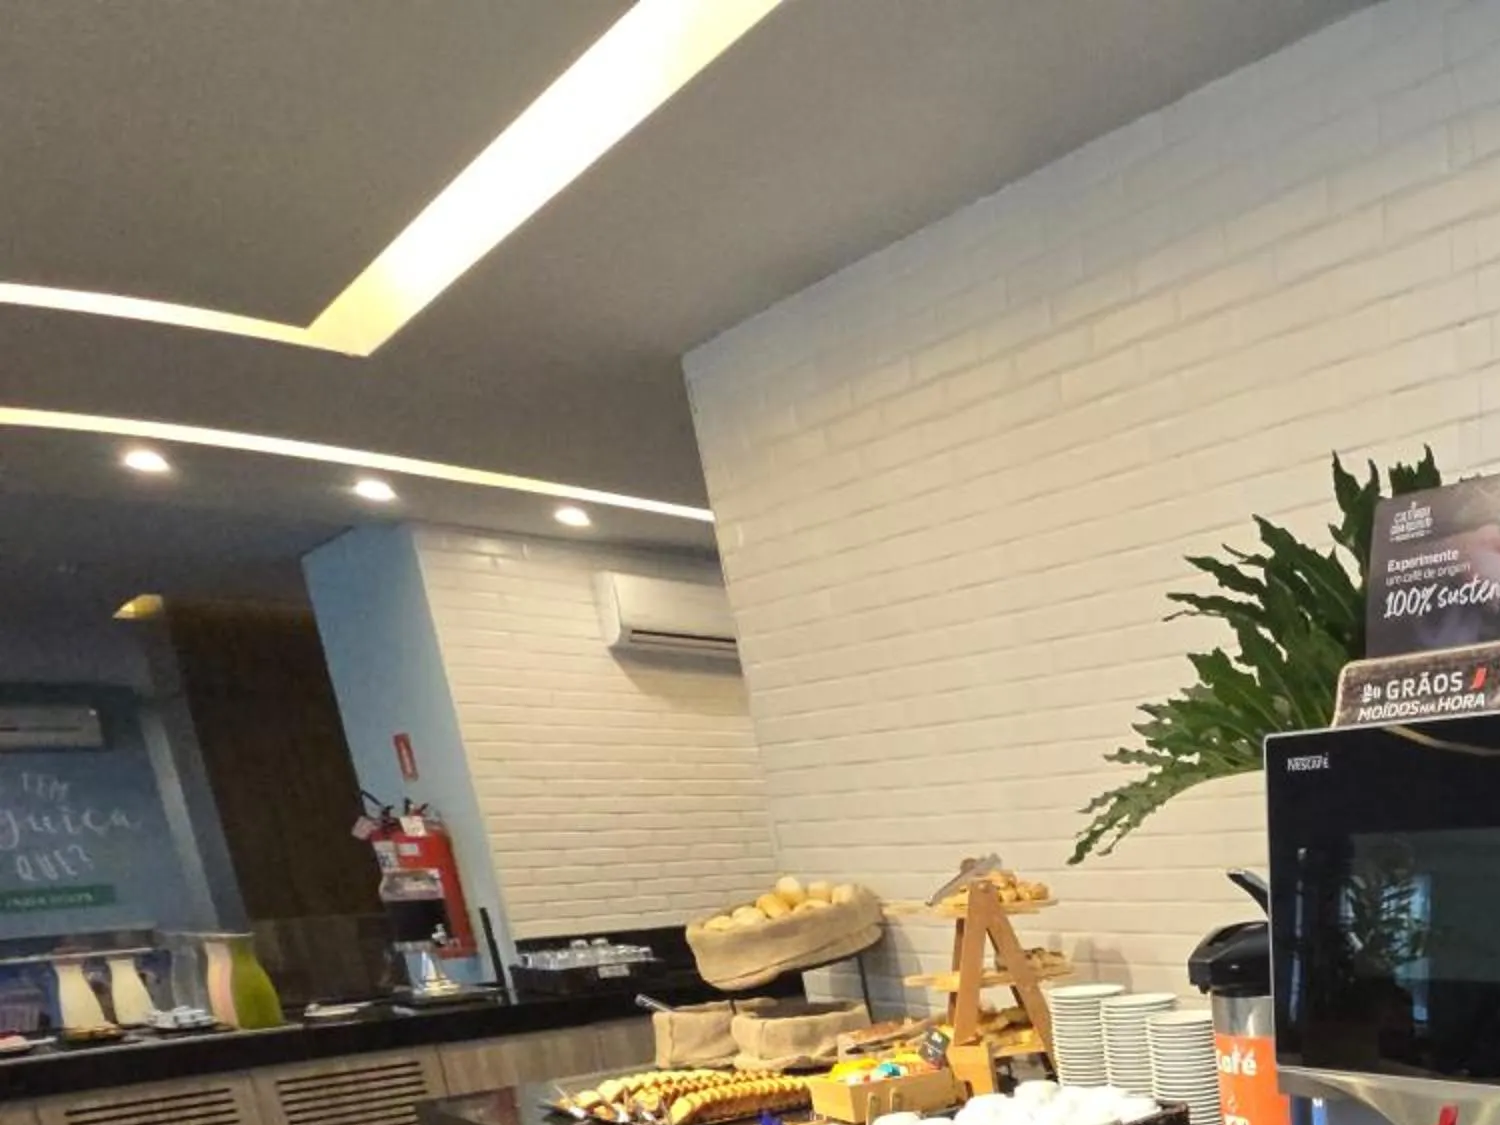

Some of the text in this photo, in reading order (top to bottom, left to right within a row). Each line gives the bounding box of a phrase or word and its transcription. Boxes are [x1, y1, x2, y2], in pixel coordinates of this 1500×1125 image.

[1387, 549, 1460, 574] Experimente
[1383, 583, 1438, 619] 100%
[1386, 671, 1463, 700] GRÃOS
[1357, 700, 1420, 721] MOÍDOS
[1437, 692, 1485, 712] HORA
